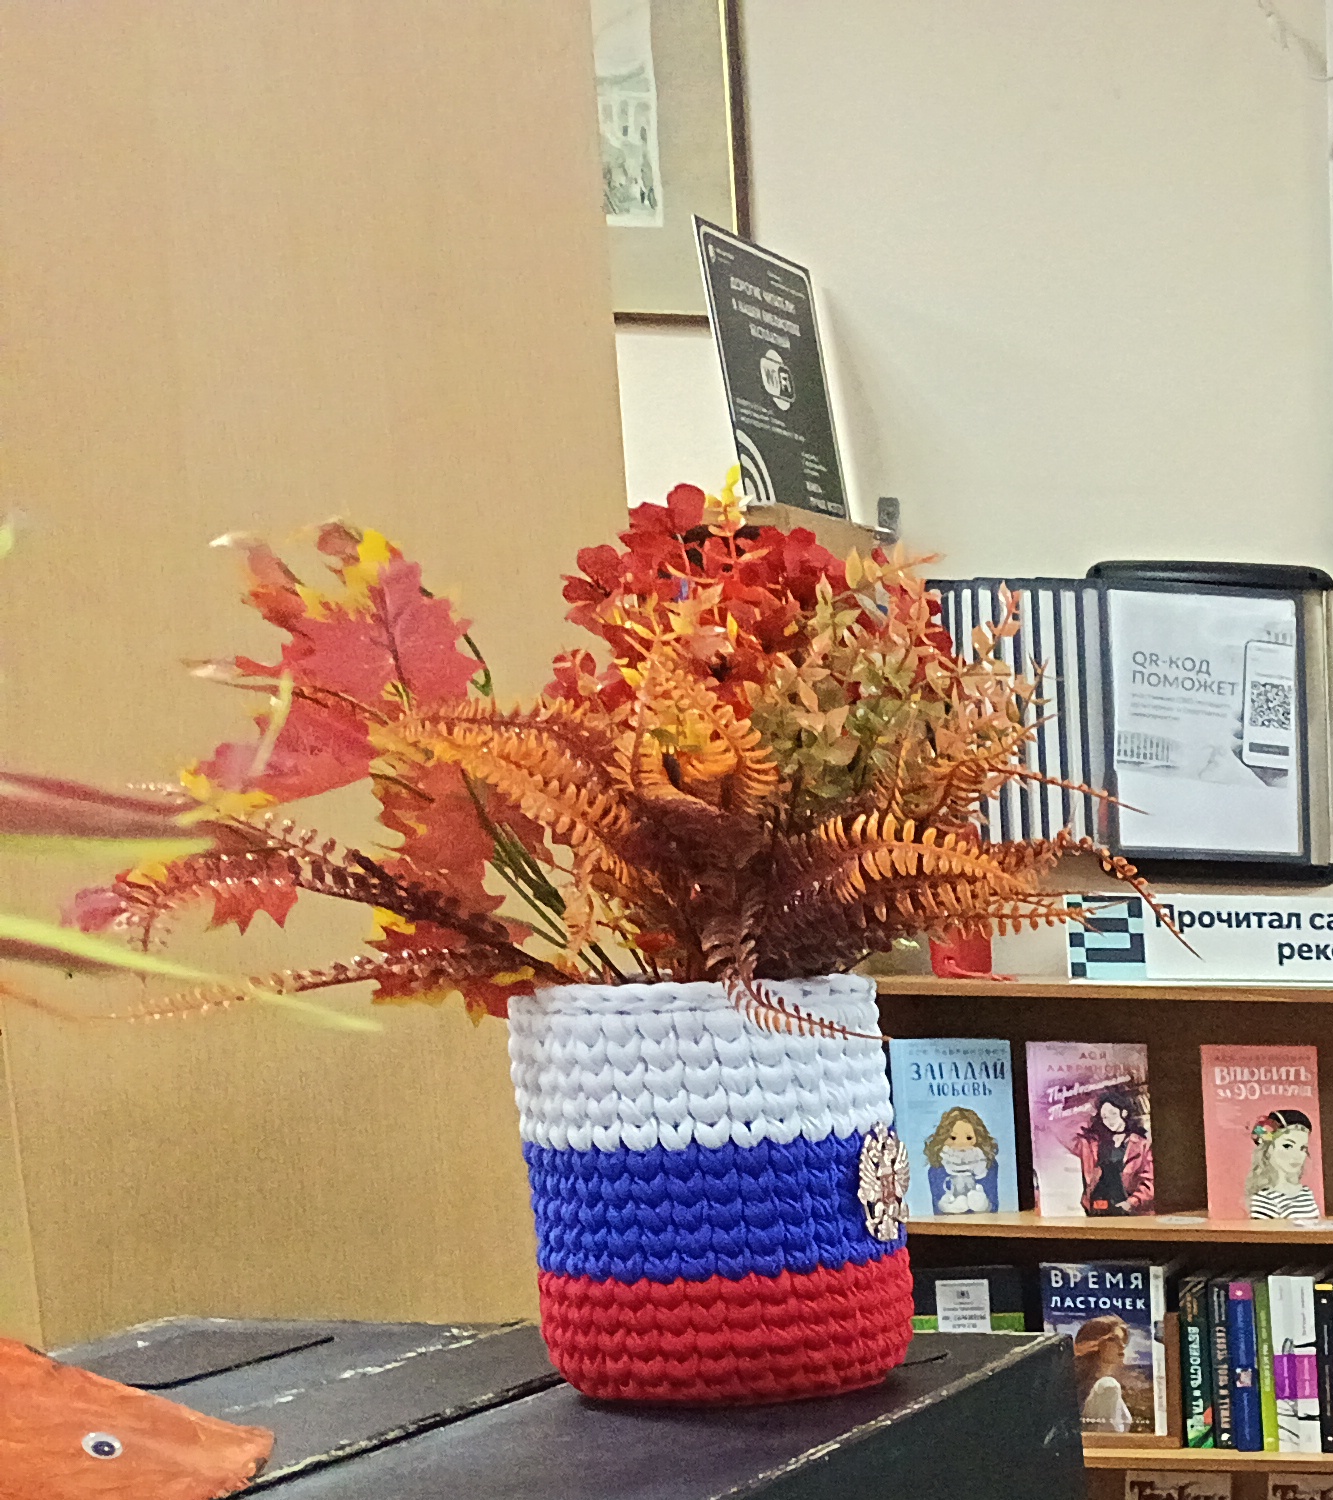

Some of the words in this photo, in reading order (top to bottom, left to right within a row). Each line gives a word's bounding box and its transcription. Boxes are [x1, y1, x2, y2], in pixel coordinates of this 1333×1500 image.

[1132, 650, 1212, 678] QR-КОД
[1132, 670, 1239, 696] ПОМОЖЕТ
[1155, 903, 1302, 934] Прочитал
[910, 1058, 1006, 1081] ЗАГАДАЙ
[1214, 1065, 1313, 1085] ВЛЮБИТЬ
[927, 1081, 993, 1097] ЛЮБОВЬ
[1234, 1082, 1260, 1100] 90
[1050, 1269, 1143, 1289] ВРЕМЯ
[1050, 1296, 1146, 1310] ЛАСТОЧЕК
